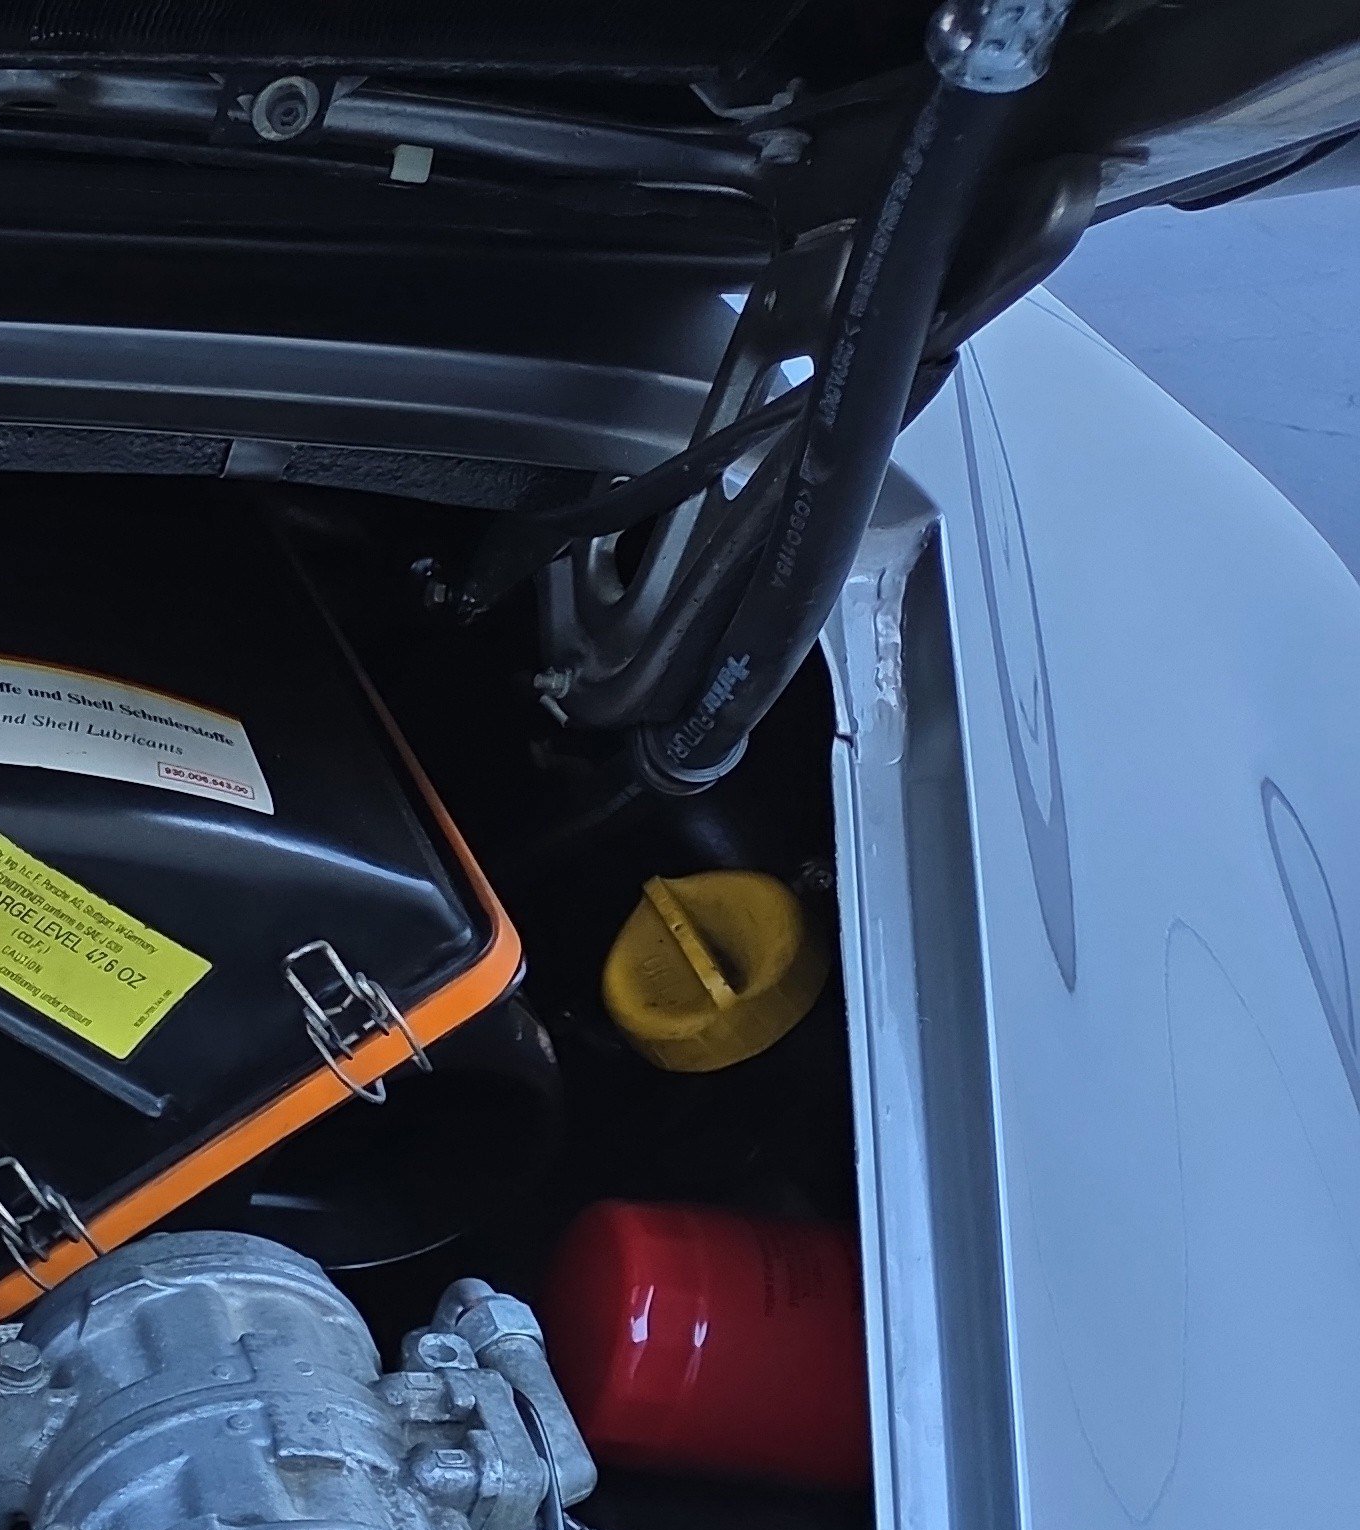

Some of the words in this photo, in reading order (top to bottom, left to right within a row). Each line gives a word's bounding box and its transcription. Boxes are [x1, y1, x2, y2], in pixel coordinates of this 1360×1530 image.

[28, 688, 62, 701] und
[67, 692, 114, 712] Shell
[119, 703, 235, 747] Schmierstoffe
[32, 714, 79, 733] Shell
[86, 723, 184, 756] Lubricants
[1, 945, 43, 974] CAUTION
[33, 915, 83, 954] LEVEL
[85, 948, 119, 973] 47.6
[117, 967, 148, 990] OZ
